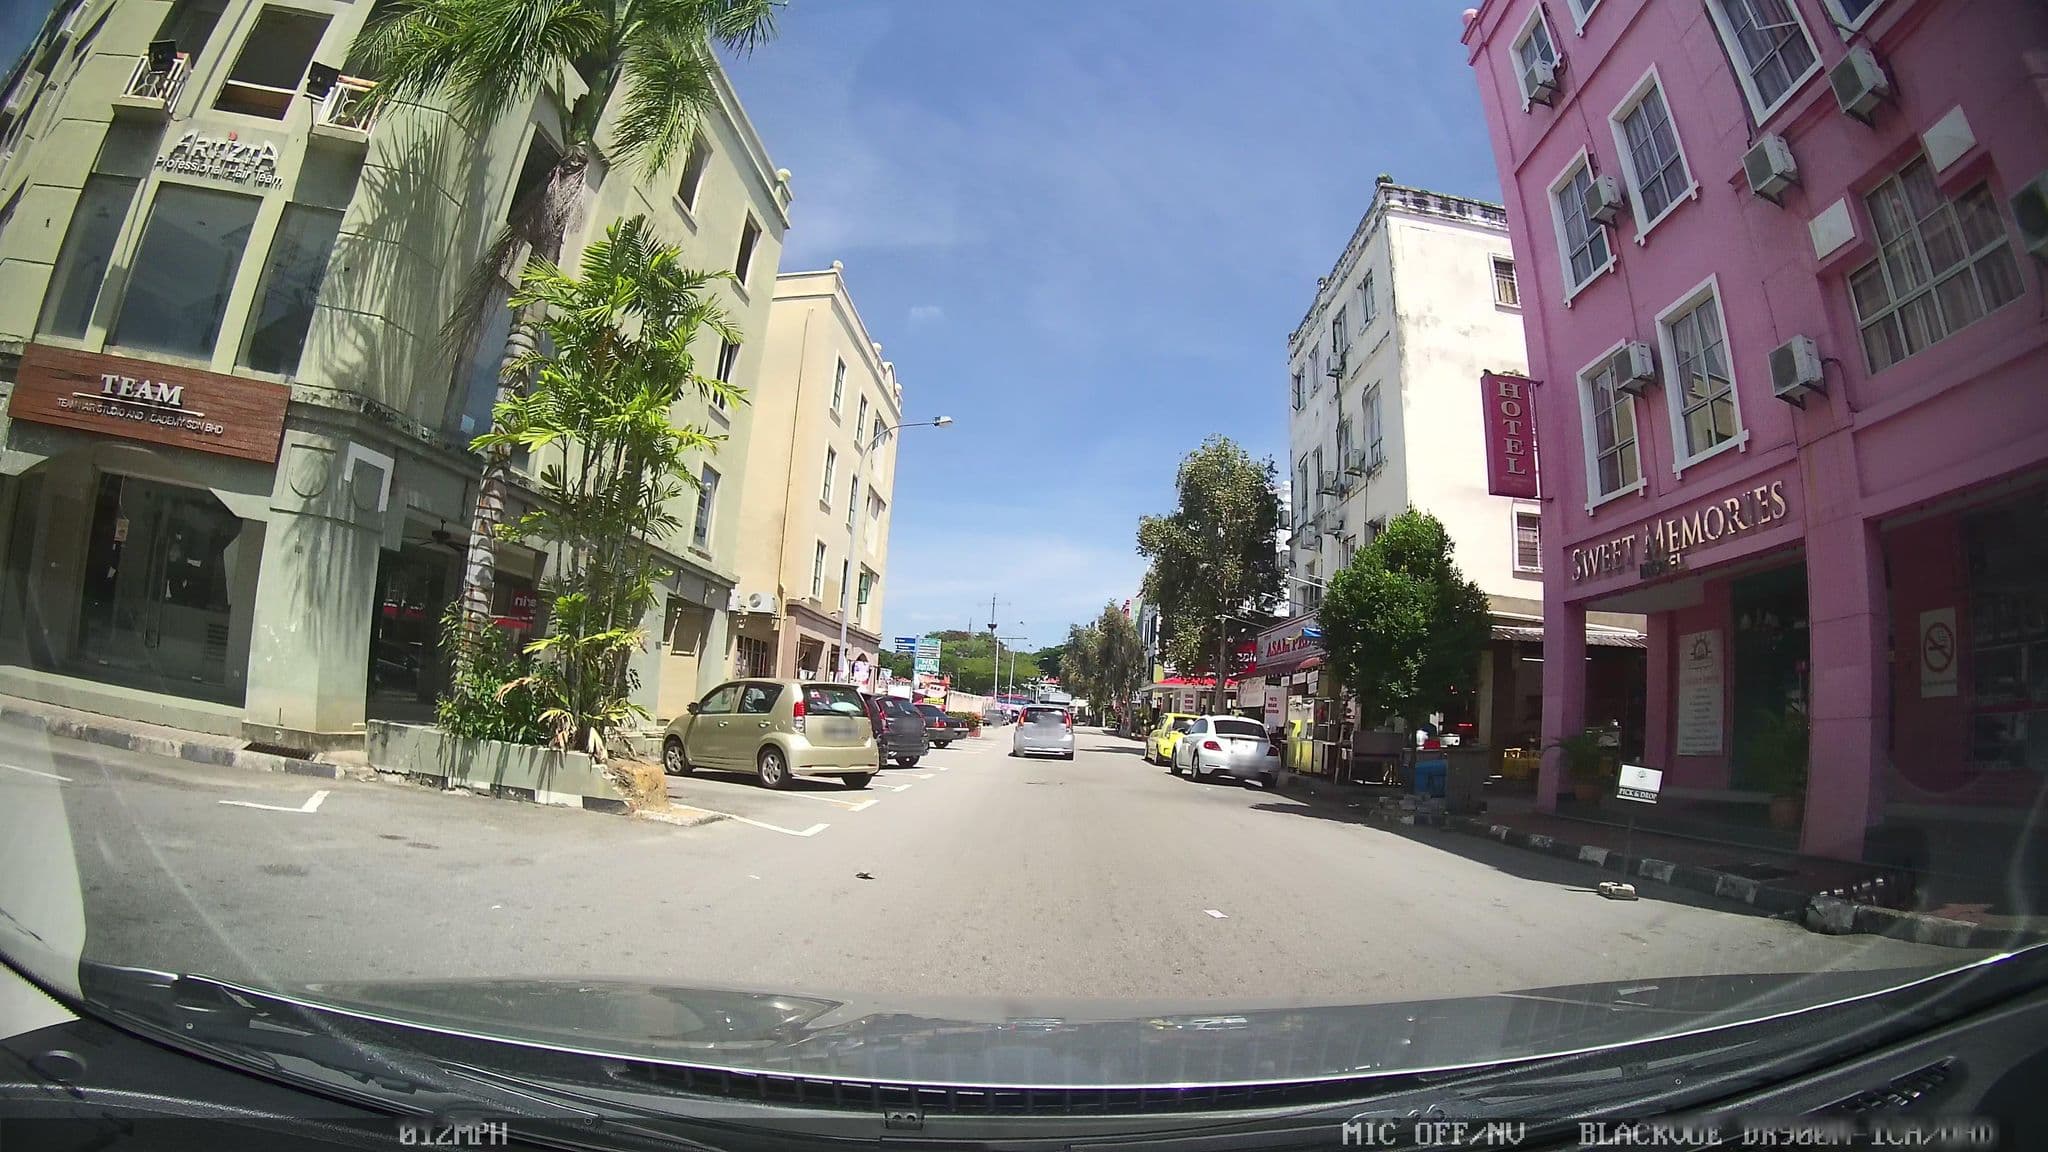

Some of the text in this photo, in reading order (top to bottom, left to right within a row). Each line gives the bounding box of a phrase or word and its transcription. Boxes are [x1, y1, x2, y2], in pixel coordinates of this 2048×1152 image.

[155, 155, 283, 188] Professional Hair Team
[101, 373, 184, 406] TEAM
[96, 403, 125, 417] STUDIO
[126, 409, 144, 421] AND
[146, 411, 186, 427] CADEMY
[186, 418, 205, 431] SDN
[205, 422, 224, 434] BHD
[1497, 381, 1526, 476] HOTEL
[1571, 534, 1635, 581] SWEET
[1645, 480, 1787, 553] MEMORIES
[1618, 787, 1634, 797] PICK
[1640, 790, 1658, 800] DROP
